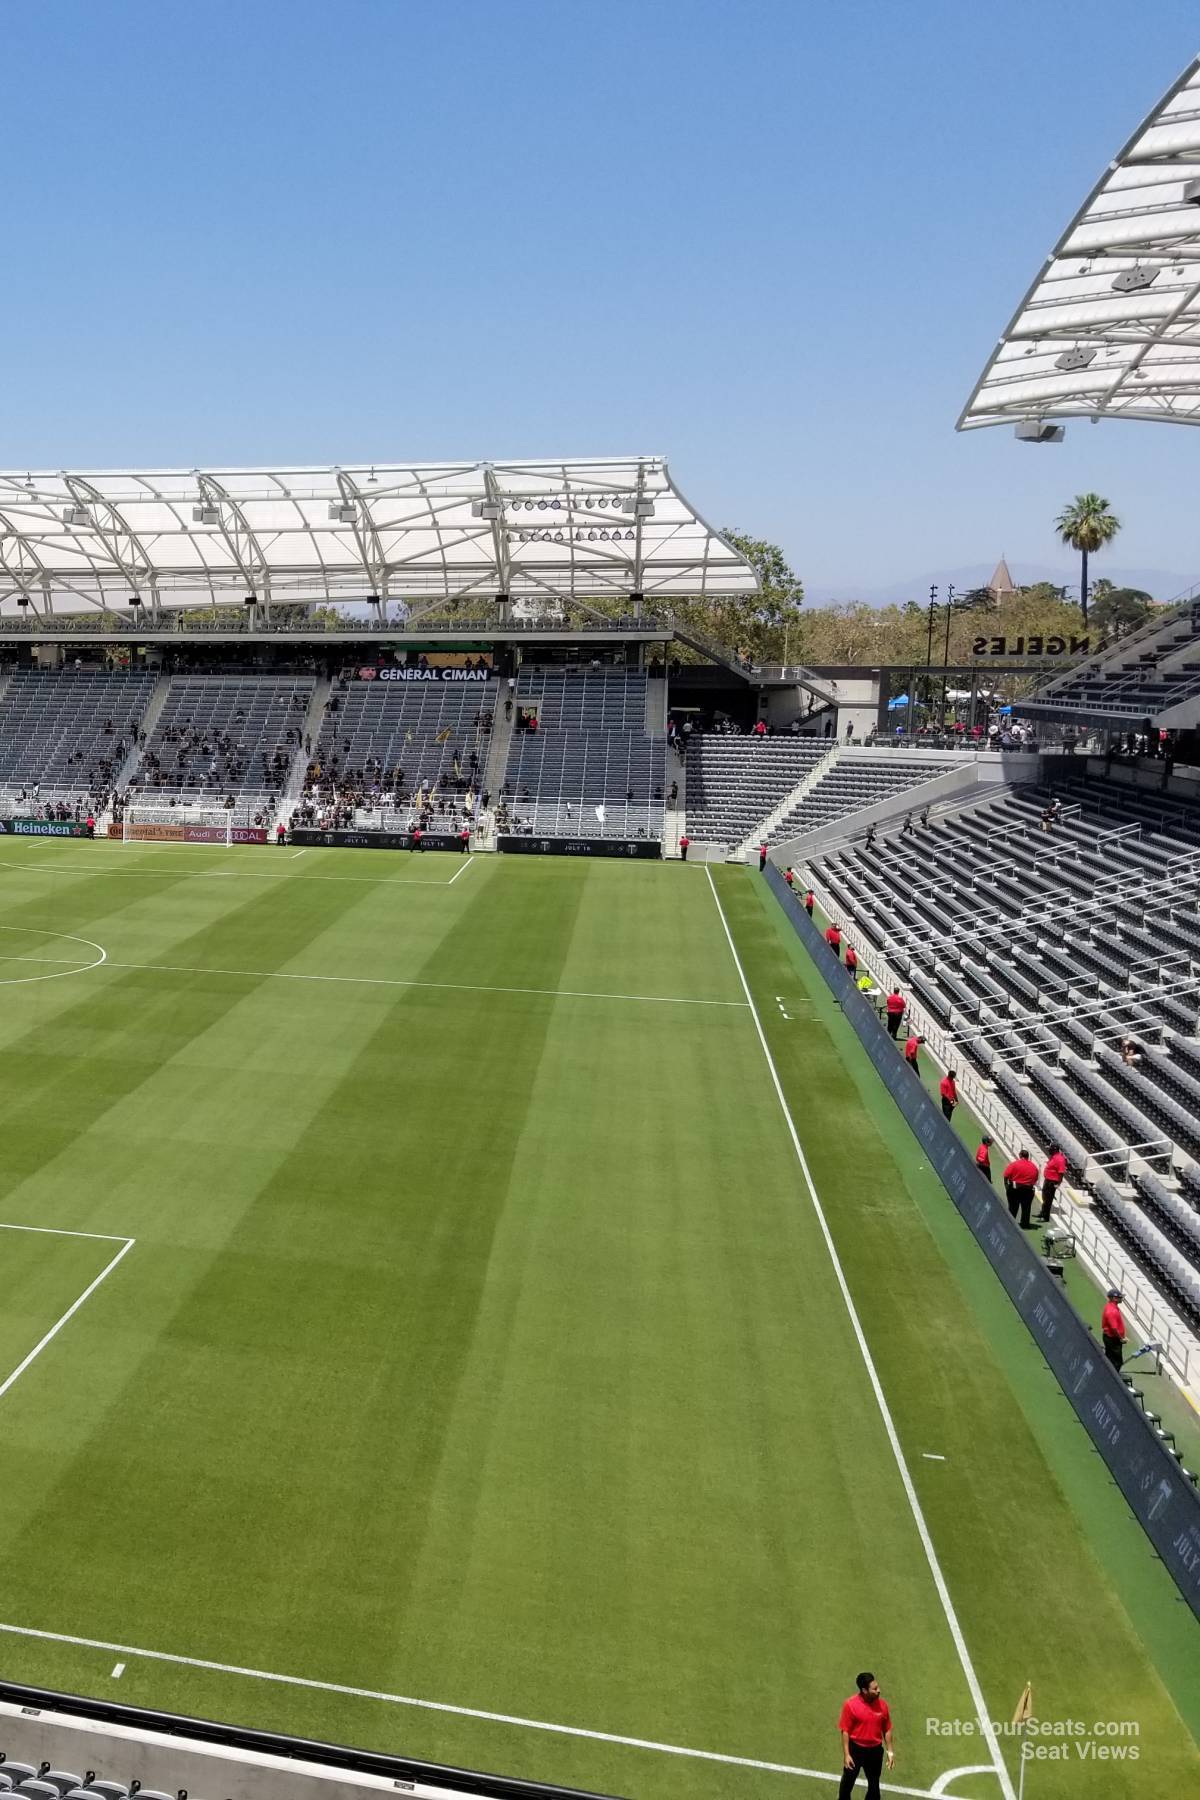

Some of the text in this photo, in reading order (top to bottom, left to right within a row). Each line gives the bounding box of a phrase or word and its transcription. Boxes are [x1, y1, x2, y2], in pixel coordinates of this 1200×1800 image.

[442, 669, 488, 681] CIMAN
[13, 822, 70, 835] Heineken
[189, 830, 210, 838] Audi
[1092, 1399, 1112, 1429] JULY
[1108, 1424, 1120, 1445] 18
[1173, 1532, 1200, 1573] JULY
